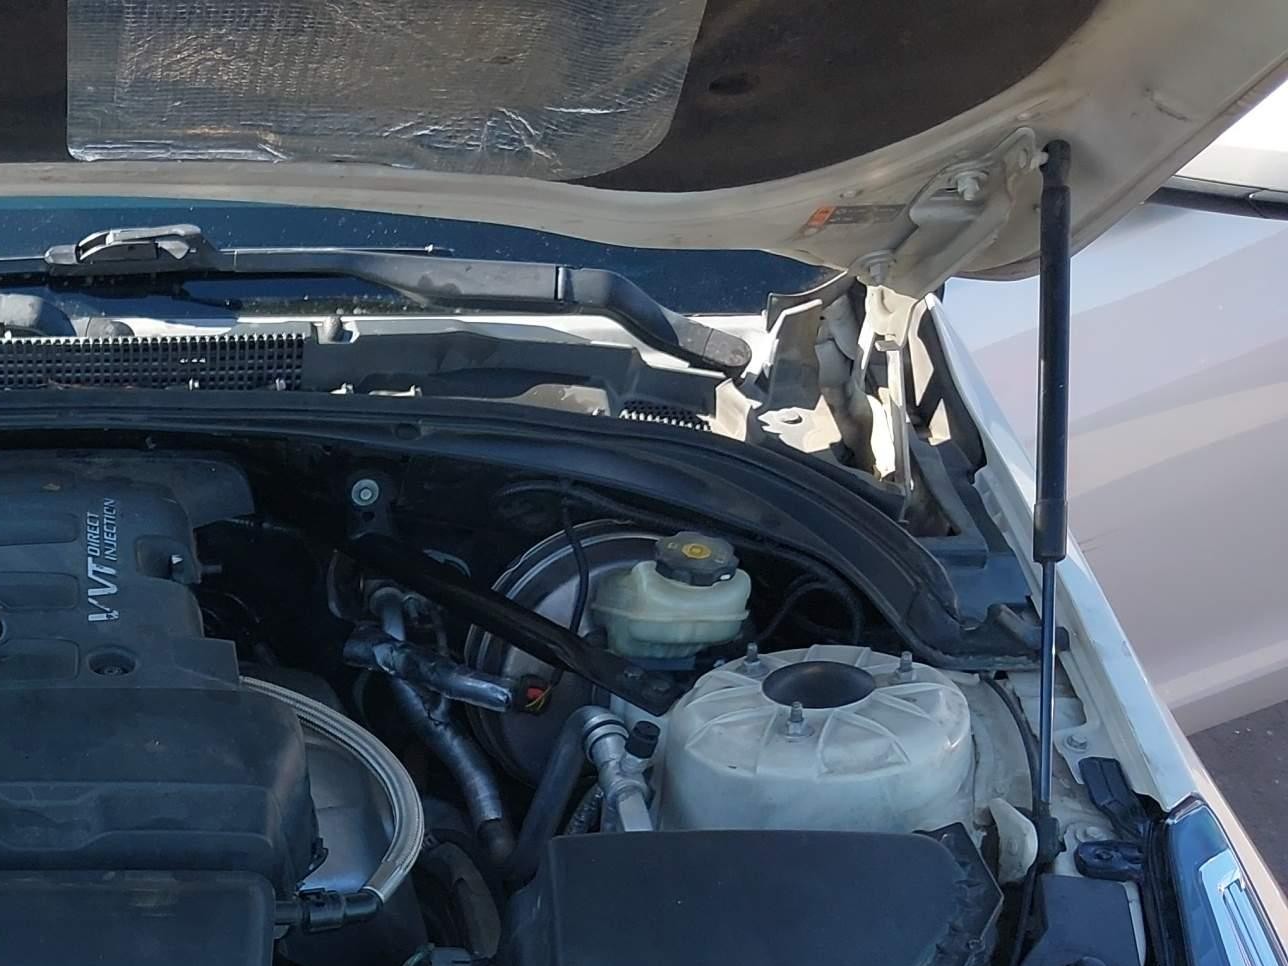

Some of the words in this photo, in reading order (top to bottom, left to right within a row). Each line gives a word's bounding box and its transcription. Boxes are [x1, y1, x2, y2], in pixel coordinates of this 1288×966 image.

[86, 511, 100, 556] DIRECT
[103, 497, 118, 560] INJECTION
[87, 557, 119, 622] VVT
